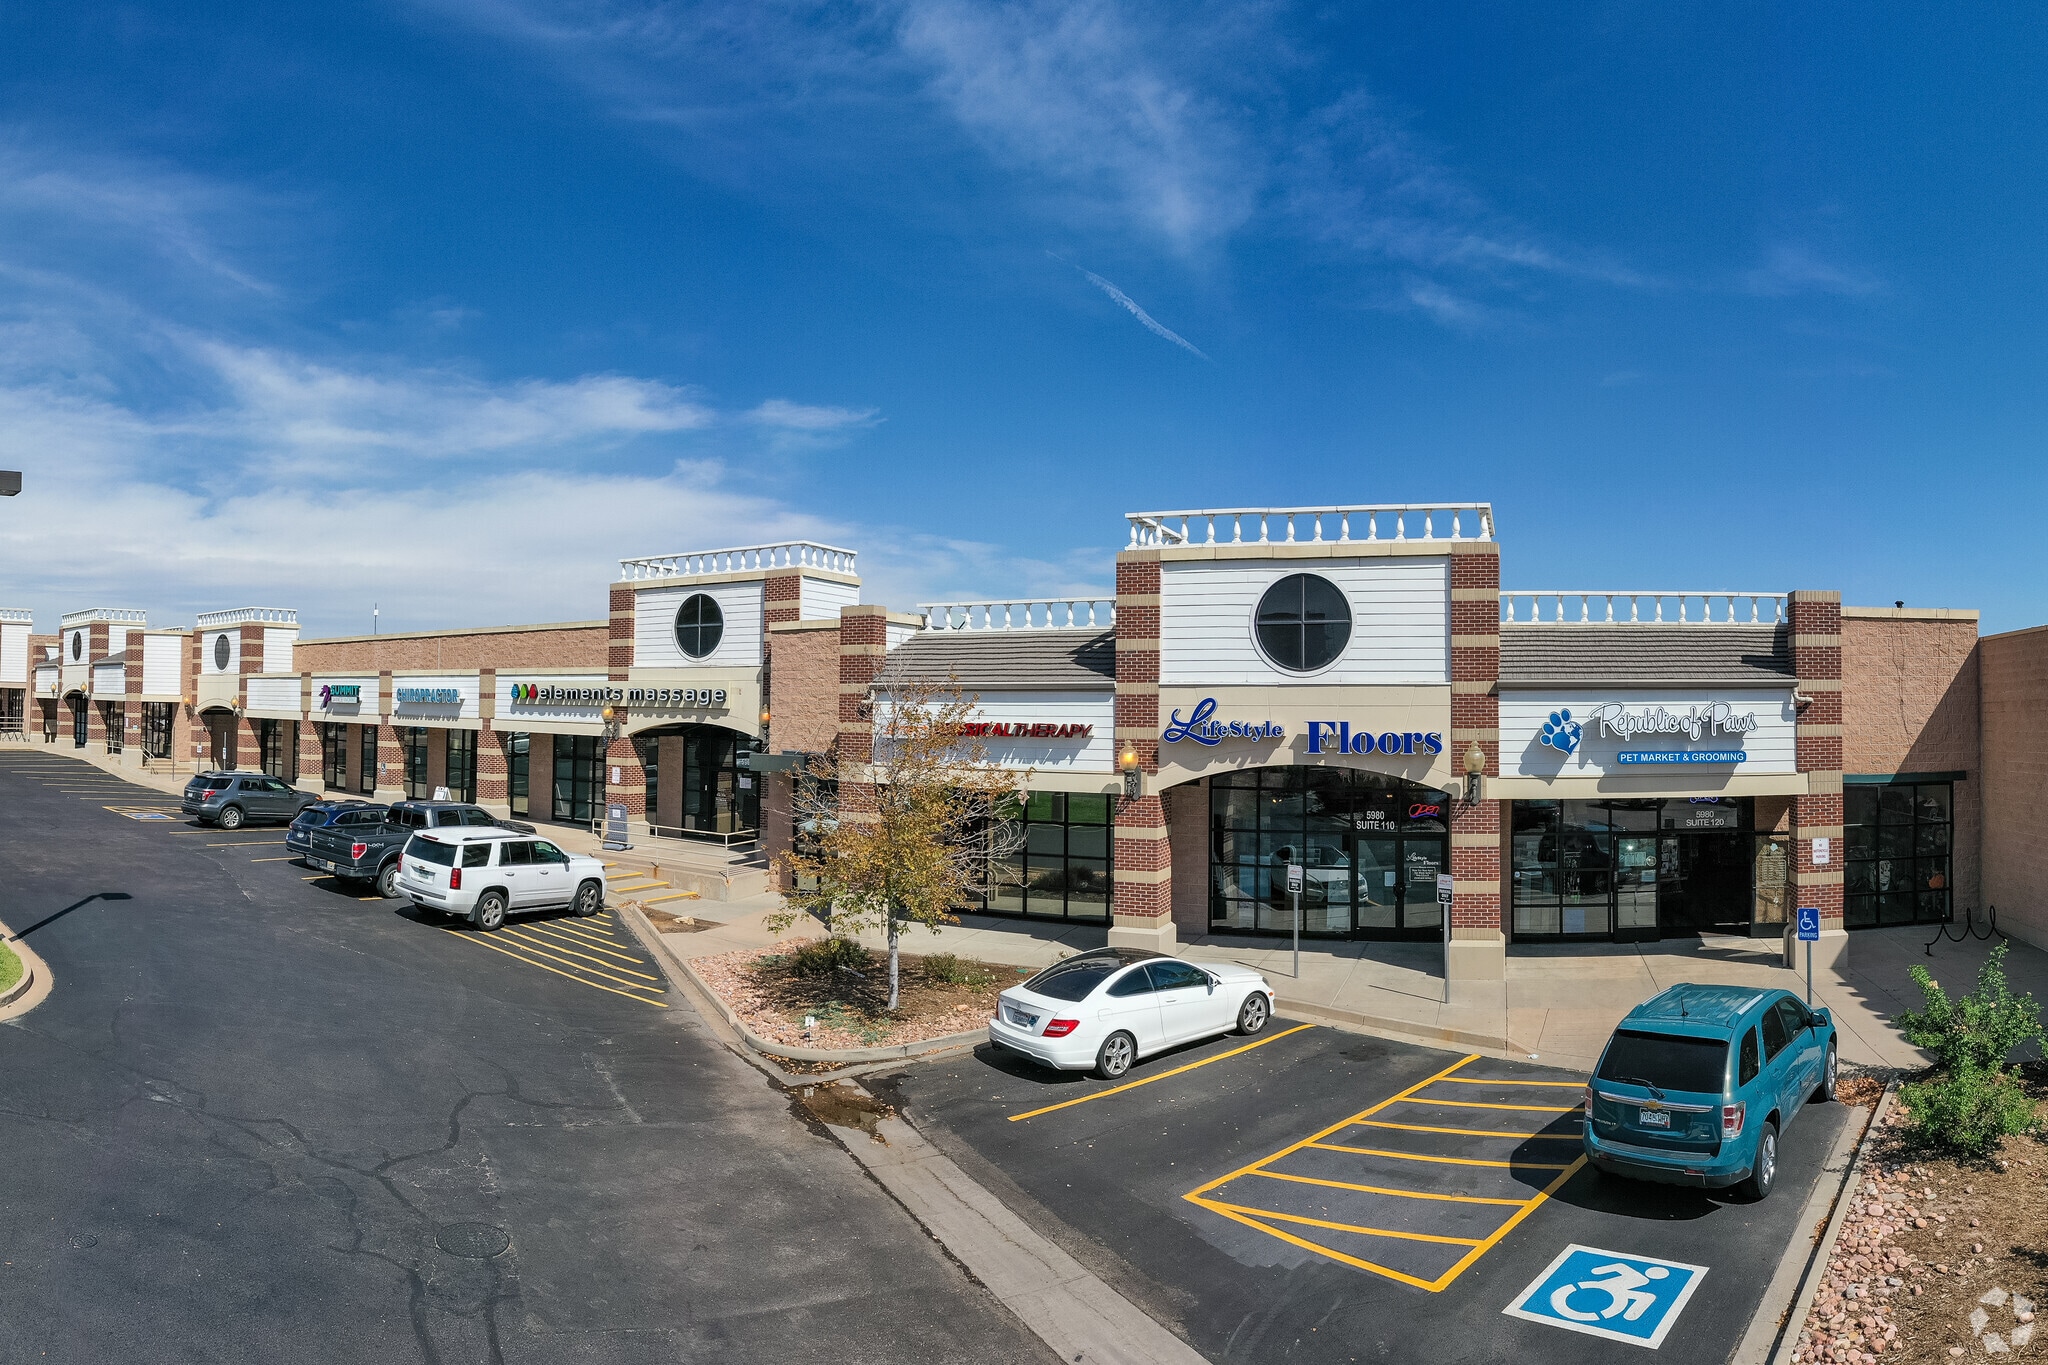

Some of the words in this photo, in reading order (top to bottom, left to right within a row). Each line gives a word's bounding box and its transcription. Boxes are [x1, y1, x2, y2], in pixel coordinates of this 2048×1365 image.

[330, 685, 359, 696] SUMMIT
[397, 688, 459, 703] CHIROPRACTOR
[539, 685, 622, 701] elements
[627, 686, 727, 706] massage
[1163, 697, 1284, 747] LifeStyle
[1303, 720, 1443, 755] Floors
[1588, 701, 1680, 742] Republic
[1680, 705, 1702, 741] of
[1700, 701, 1758, 737] Paws
[1620, 753, 1638, 762] PET
[1640, 753, 1680, 762] MARKET
[1682, 753, 1690, 761] &
[1691, 753, 1744, 762] GROOMING
[1366, 810, 1385, 820] 5980
[1695, 810, 1715, 819] 5980
[1356, 820, 1380, 830] SUITE
[1381, 820, 1395, 830] 110
[1686, 818, 1710, 827] SUITE
[1710, 818, 1725, 826] 120
[1799, 931, 1818, 939] PARKING
